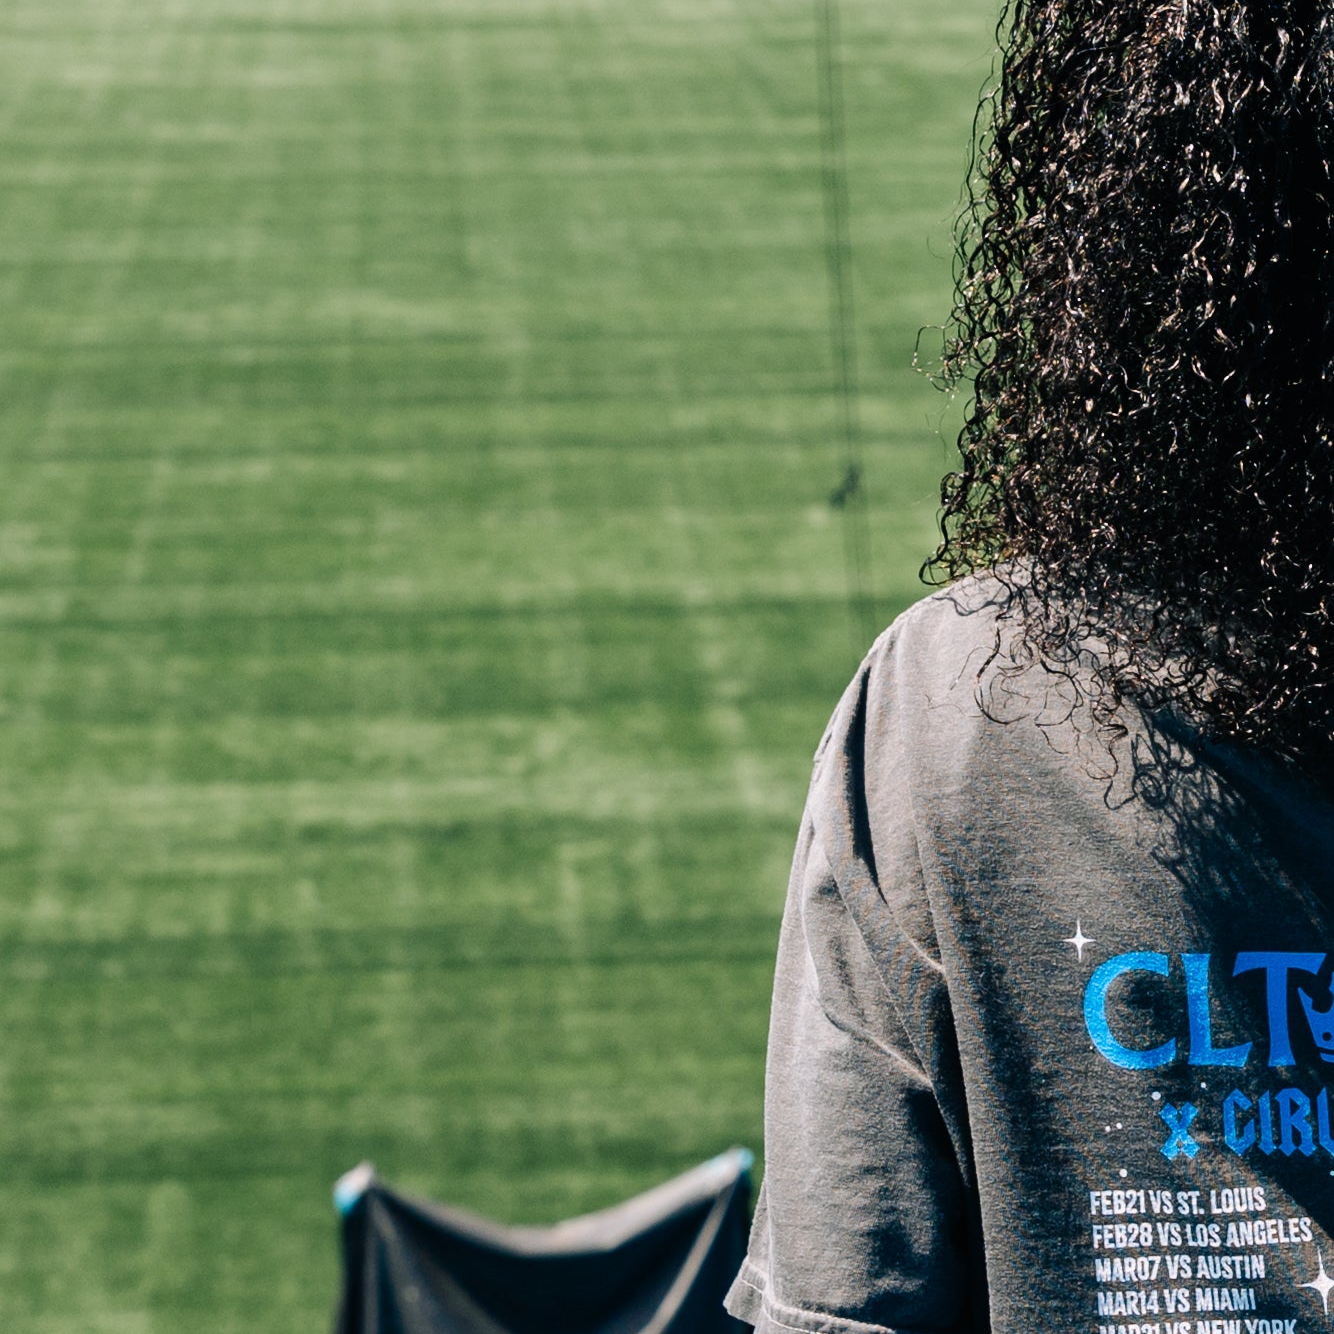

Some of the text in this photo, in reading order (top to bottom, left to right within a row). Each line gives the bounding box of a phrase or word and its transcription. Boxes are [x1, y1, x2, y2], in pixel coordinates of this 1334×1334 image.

[1082, 951, 1326, 1069] CLT
[1090, 1187, 1266, 1215] FEB21 VS ST. LOUIS
[1092, 1217, 1313, 1249] FEB28 VS LOS ANGELES
[1095, 1255, 1265, 1282] MAR07 VS AUSTIN
[1097, 1287, 1255, 1316] MAR14 VS MIAMI
